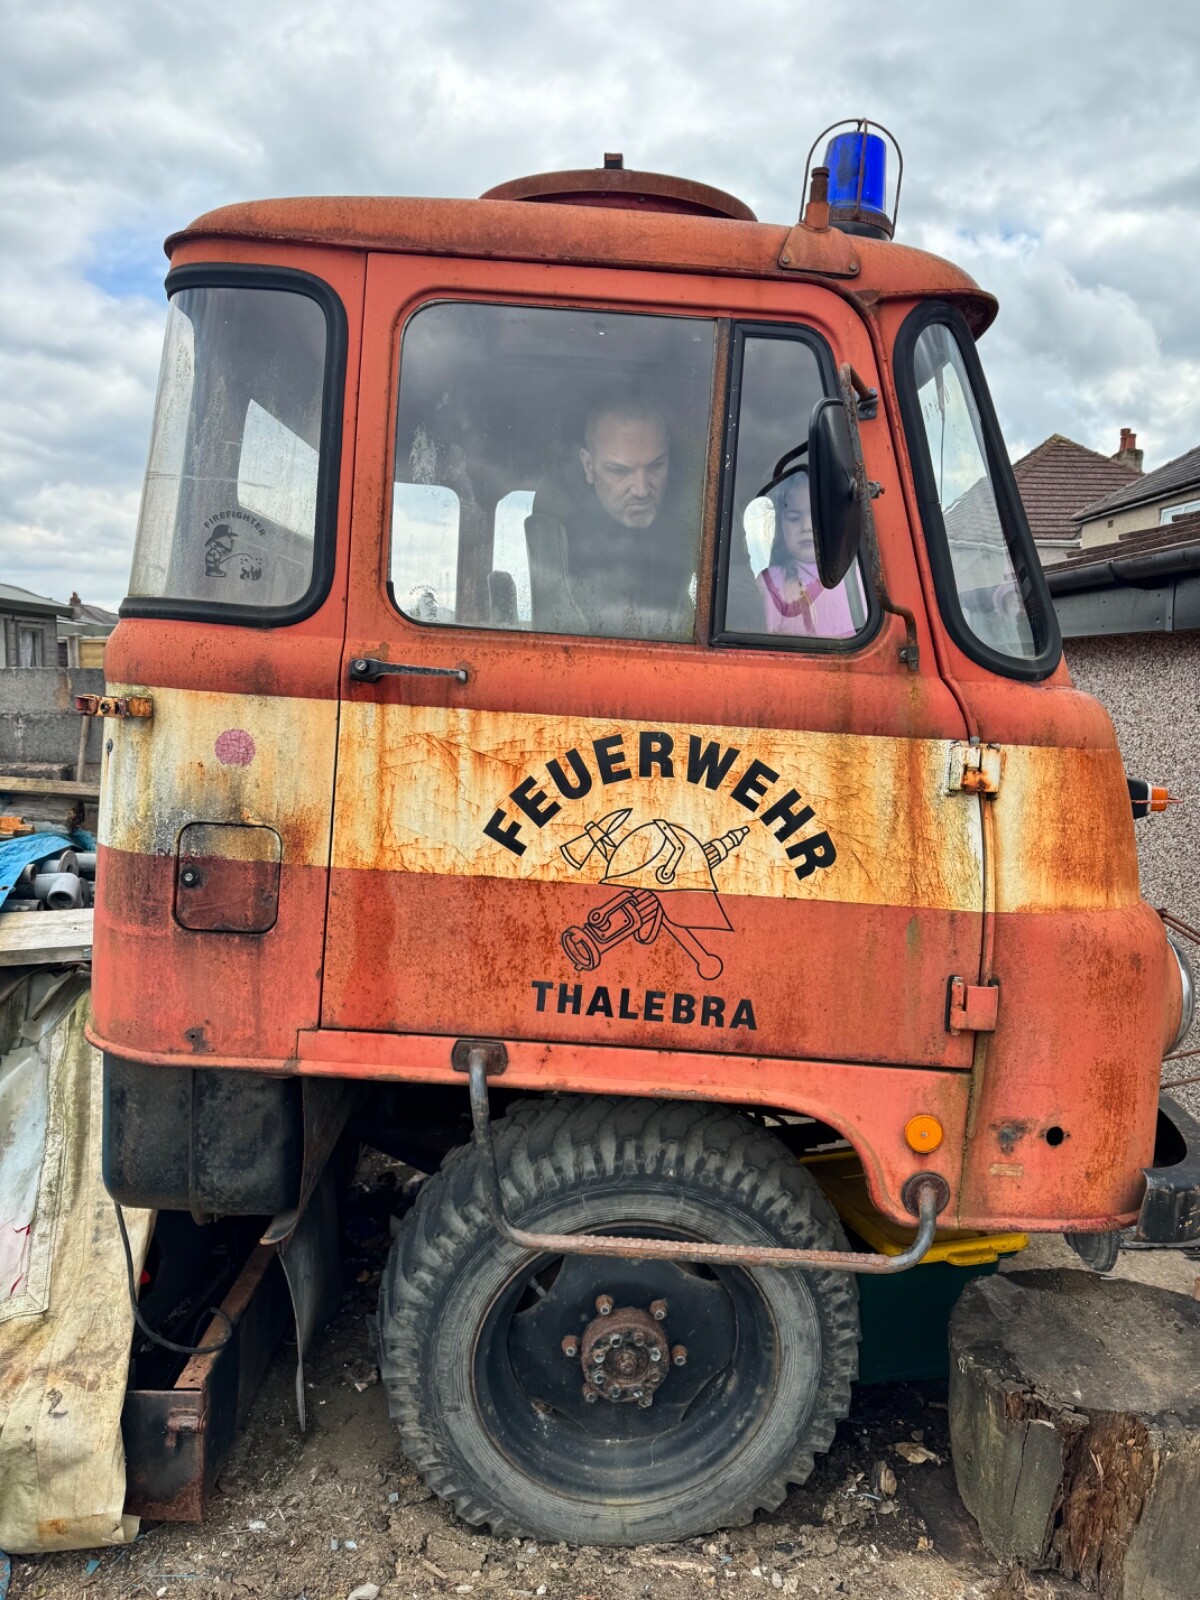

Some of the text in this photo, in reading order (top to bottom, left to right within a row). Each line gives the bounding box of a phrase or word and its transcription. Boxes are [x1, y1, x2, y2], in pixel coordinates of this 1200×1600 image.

[204, 511, 266, 536] FIREFIGHTER
[483, 731, 837, 881] FEUERWEHR
[531, 980, 757, 1030] THALEBRA
